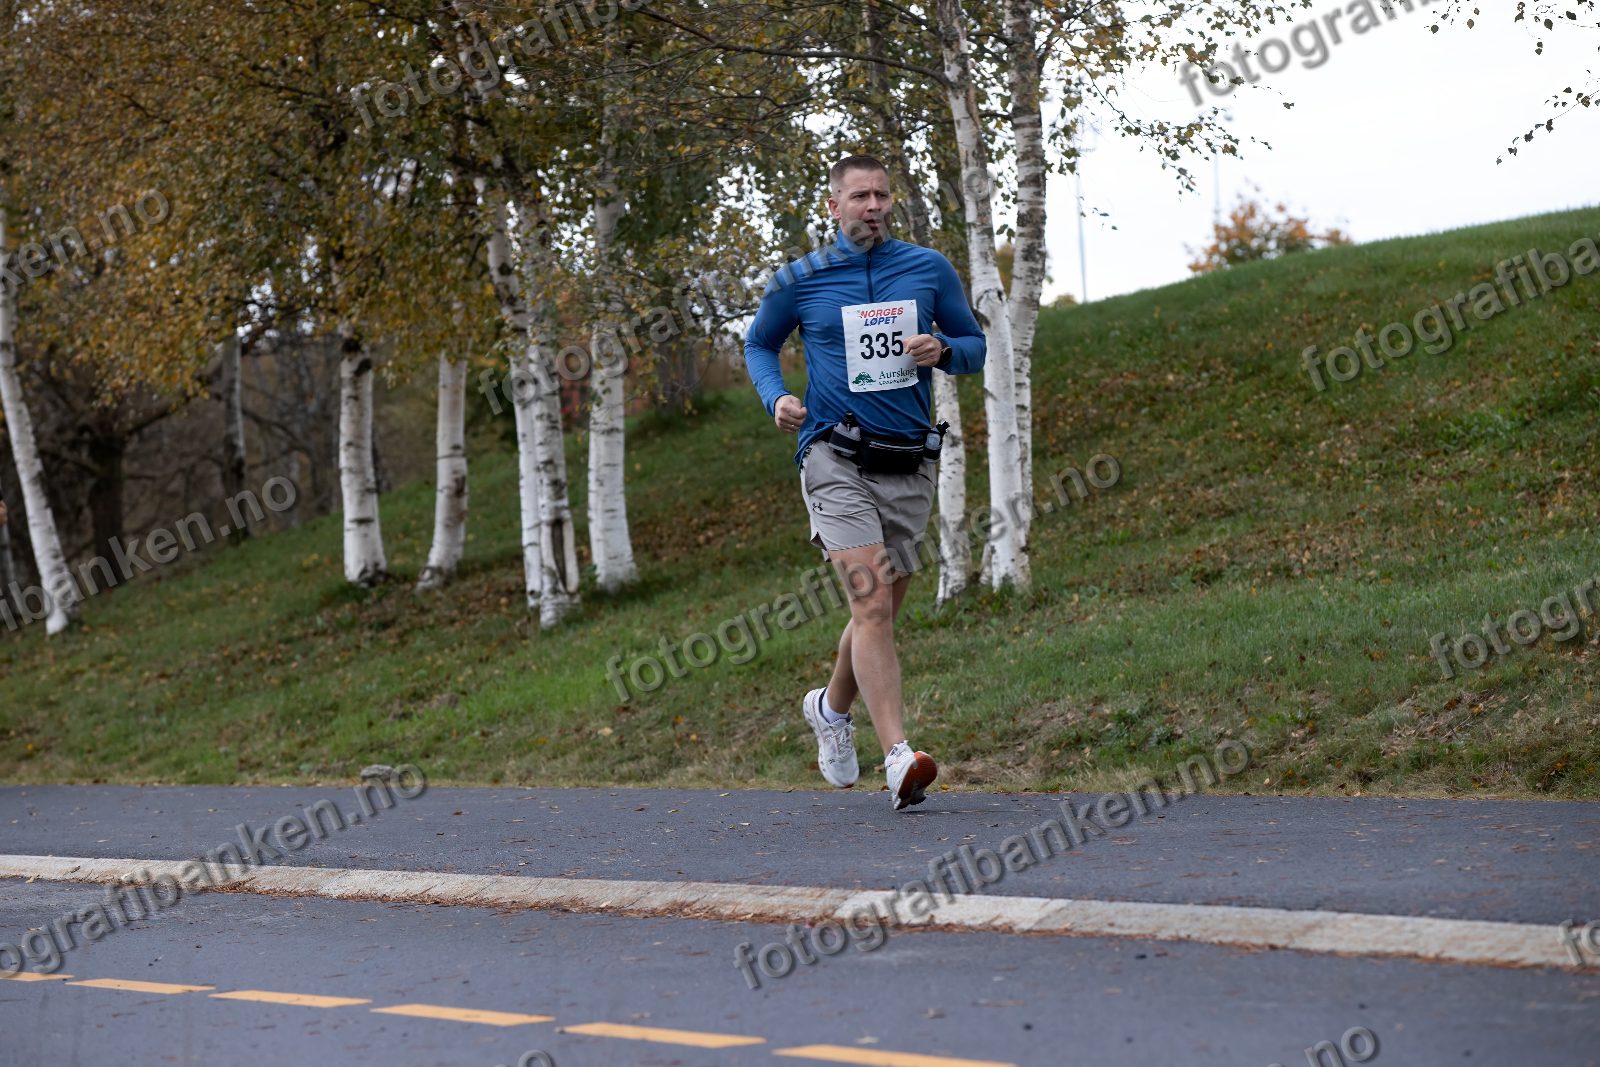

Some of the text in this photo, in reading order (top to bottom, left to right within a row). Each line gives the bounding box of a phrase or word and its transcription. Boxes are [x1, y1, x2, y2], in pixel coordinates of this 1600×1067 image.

[860, 307, 904, 319] NORGES
[864, 316, 898, 327] LØPET
[860, 330, 904, 360] 335
